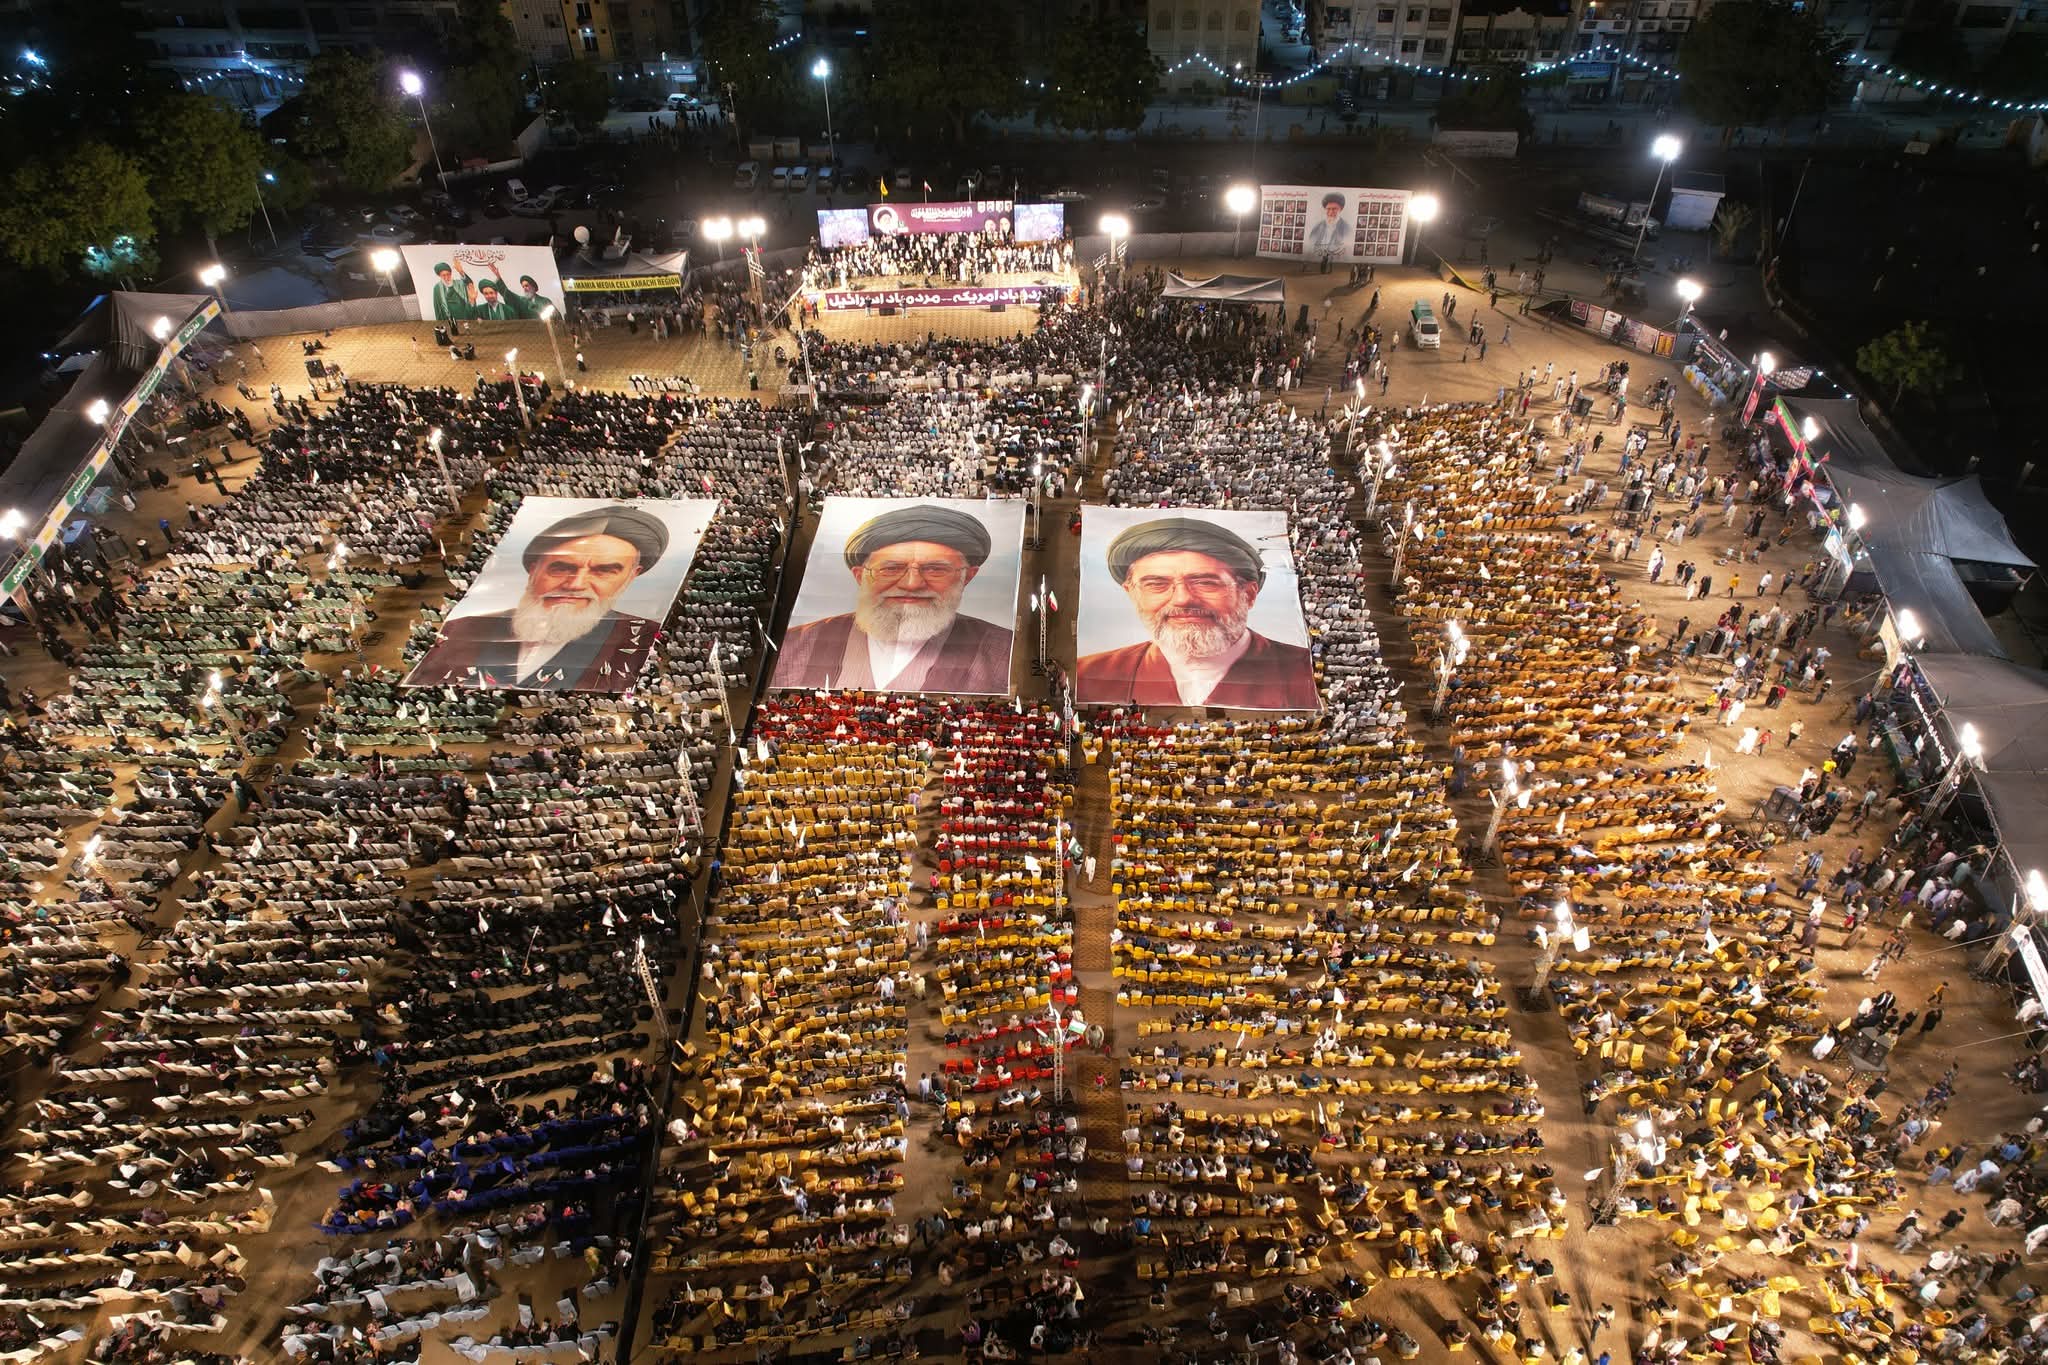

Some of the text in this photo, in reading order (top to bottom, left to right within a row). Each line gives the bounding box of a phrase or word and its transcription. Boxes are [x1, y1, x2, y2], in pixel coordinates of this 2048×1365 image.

[574, 276, 680, 290] IMAMIA MEDIA CELL KARACHI REGION
